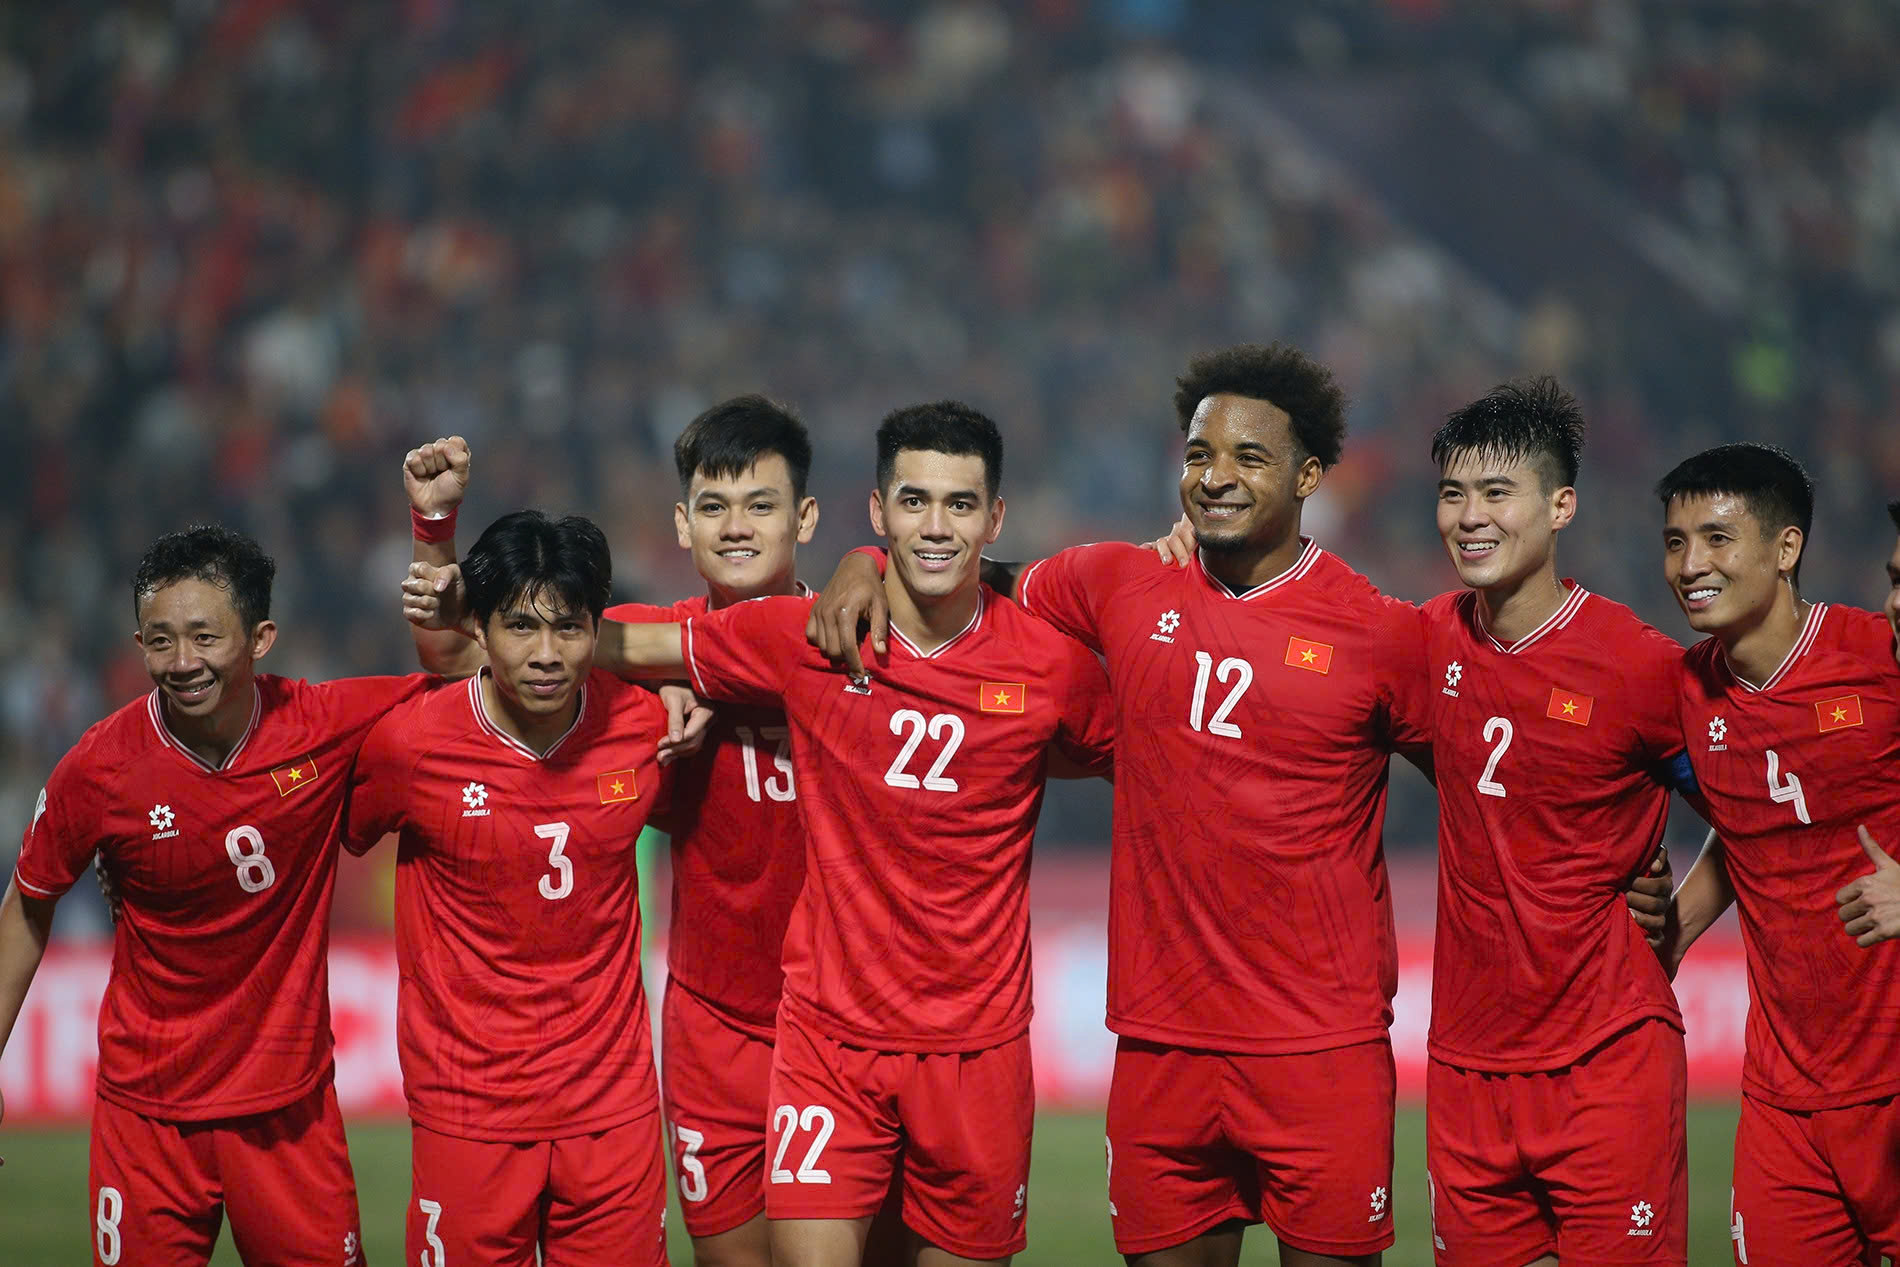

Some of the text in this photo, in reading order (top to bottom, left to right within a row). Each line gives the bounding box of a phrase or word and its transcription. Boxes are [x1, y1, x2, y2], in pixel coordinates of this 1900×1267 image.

[1190, 650, 1254, 739] 12
[736, 726, 797, 802] 13
[883, 708, 965, 792] 22
[1476, 716, 1513, 797] 2
[1766, 749, 1812, 824] 4
[225, 824, 275, 893] 8
[533, 821, 573, 900] 3
[770, 1104, 835, 1184] 22
[96, 1186, 122, 1266] 8
[419, 1198, 445, 1267] 3
